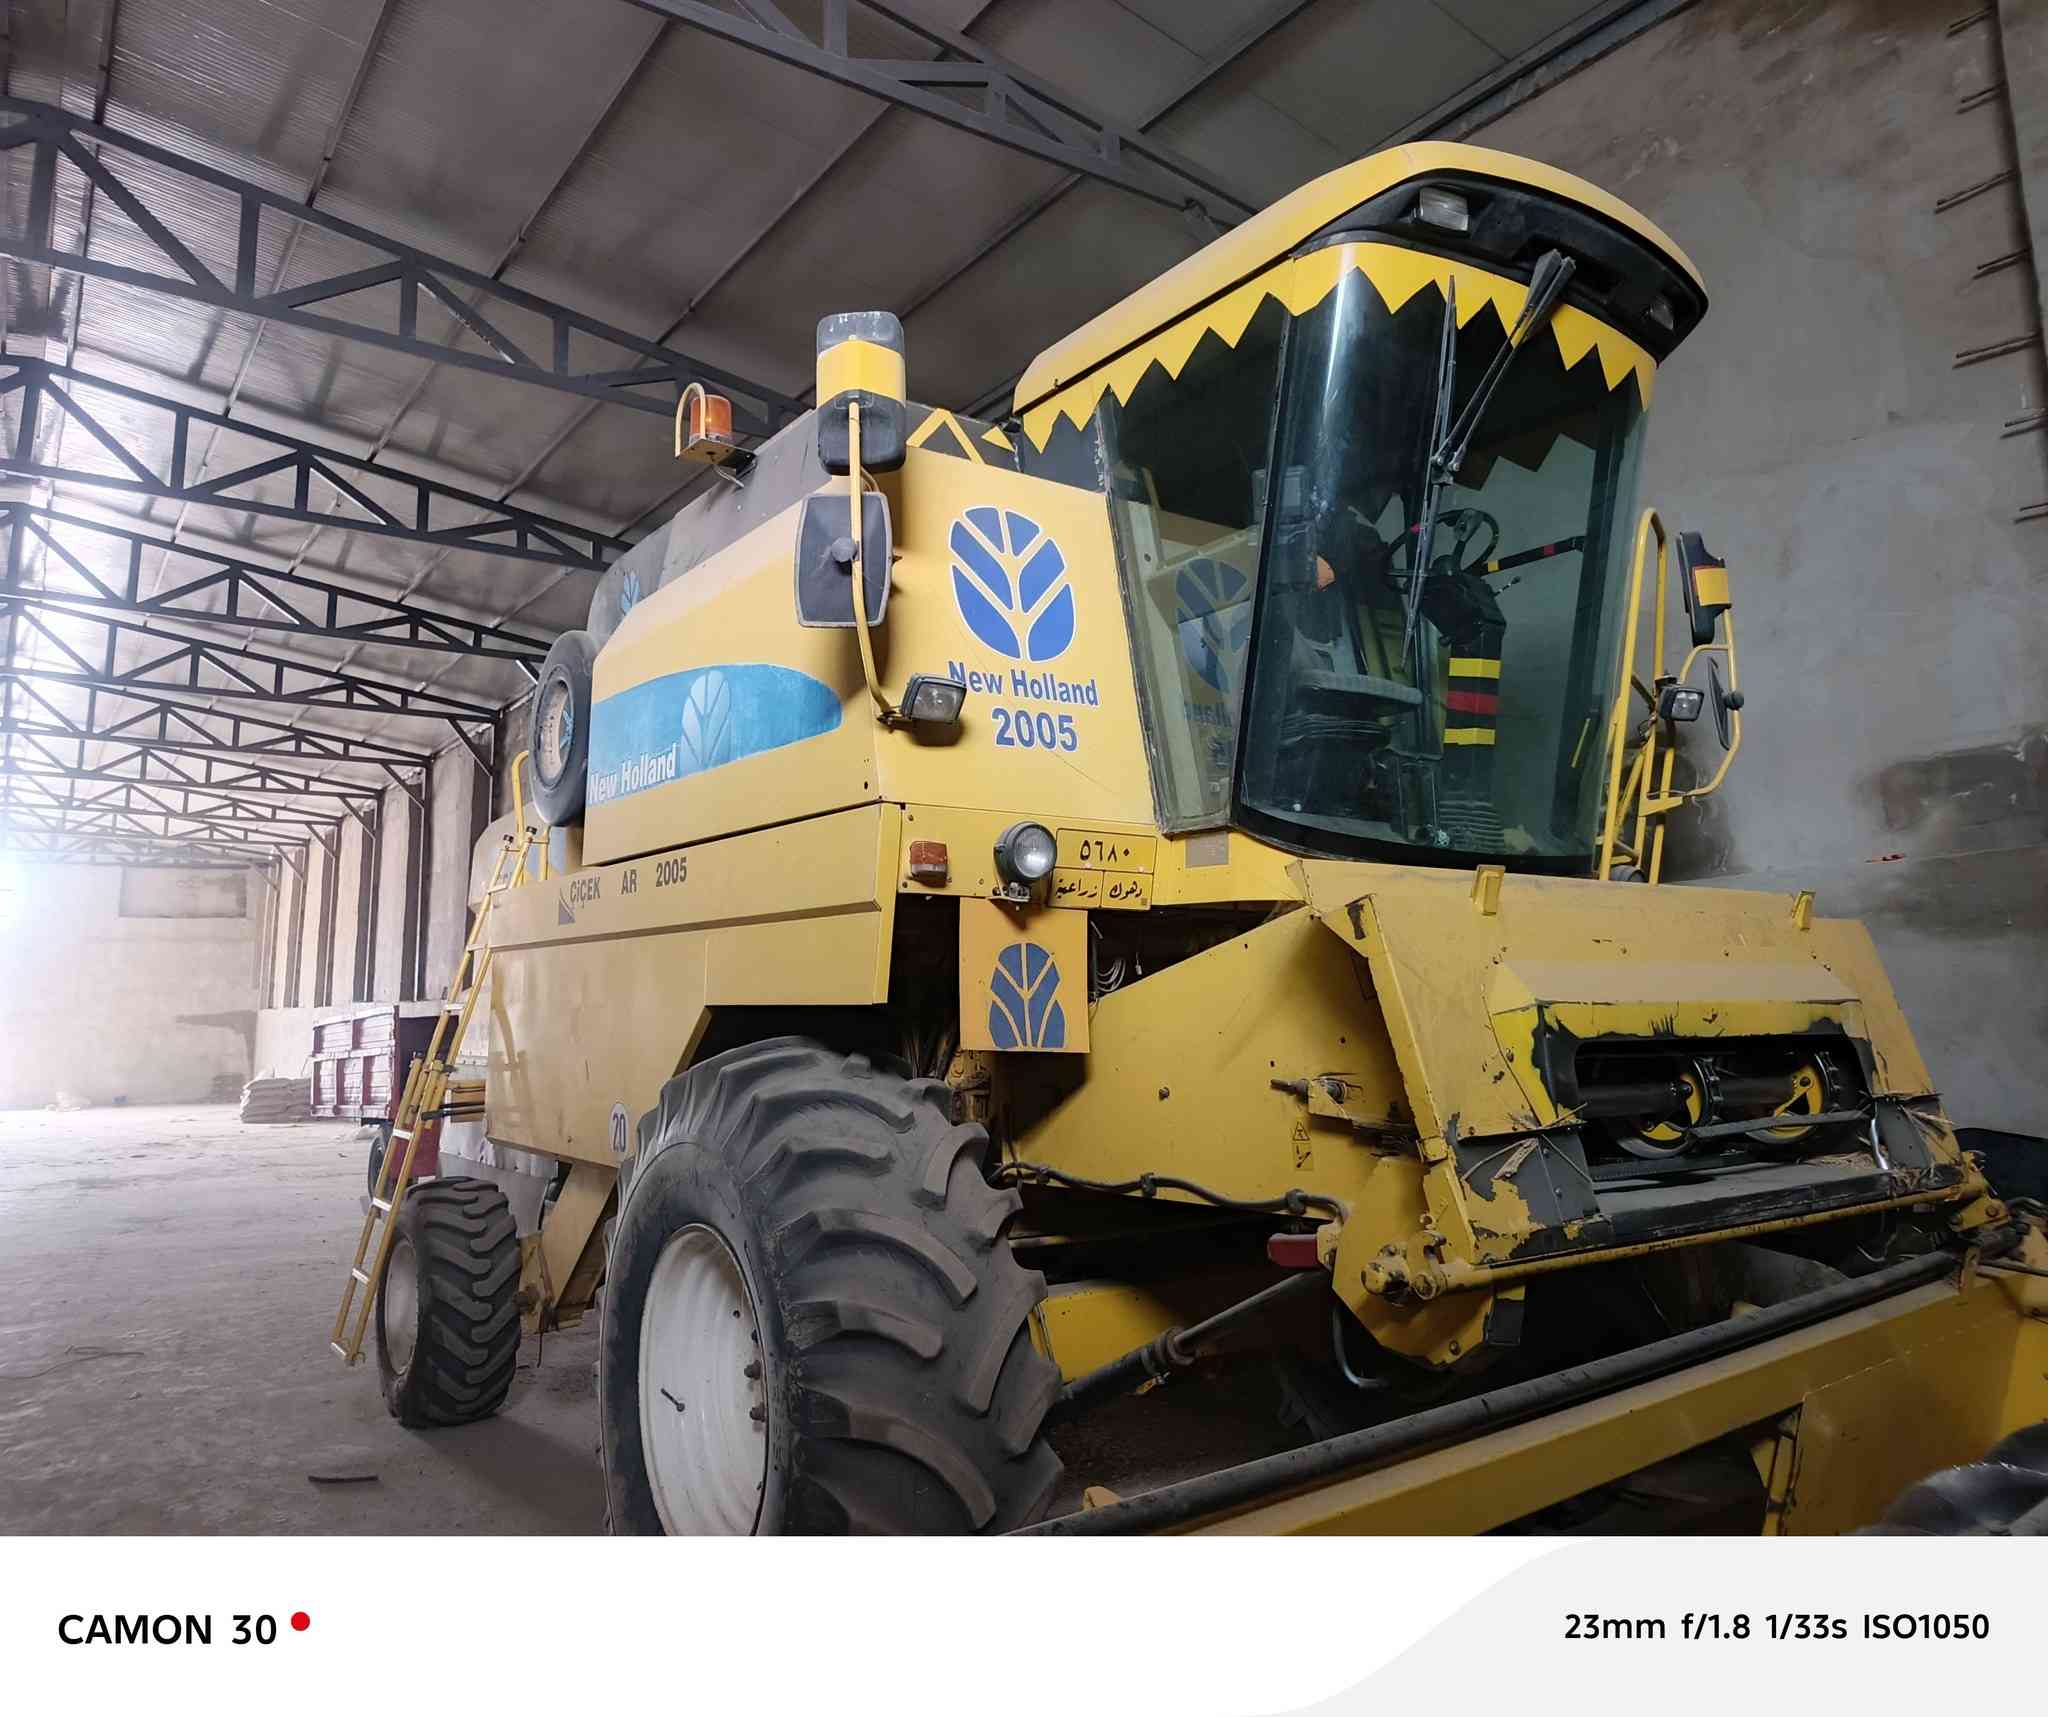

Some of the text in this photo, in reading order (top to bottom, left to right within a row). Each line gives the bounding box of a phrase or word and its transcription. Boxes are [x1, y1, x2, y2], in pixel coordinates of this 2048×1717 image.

[948, 660, 1099, 706] New Holland
[991, 707, 1078, 752] 2005
[588, 742, 677, 805] New Holland
[1080, 839, 1130, 863] ٥٦٨٠
[620, 868, 638, 895] AR
[655, 856, 688, 888] 2005
[612, 1112, 626, 1153] 20
